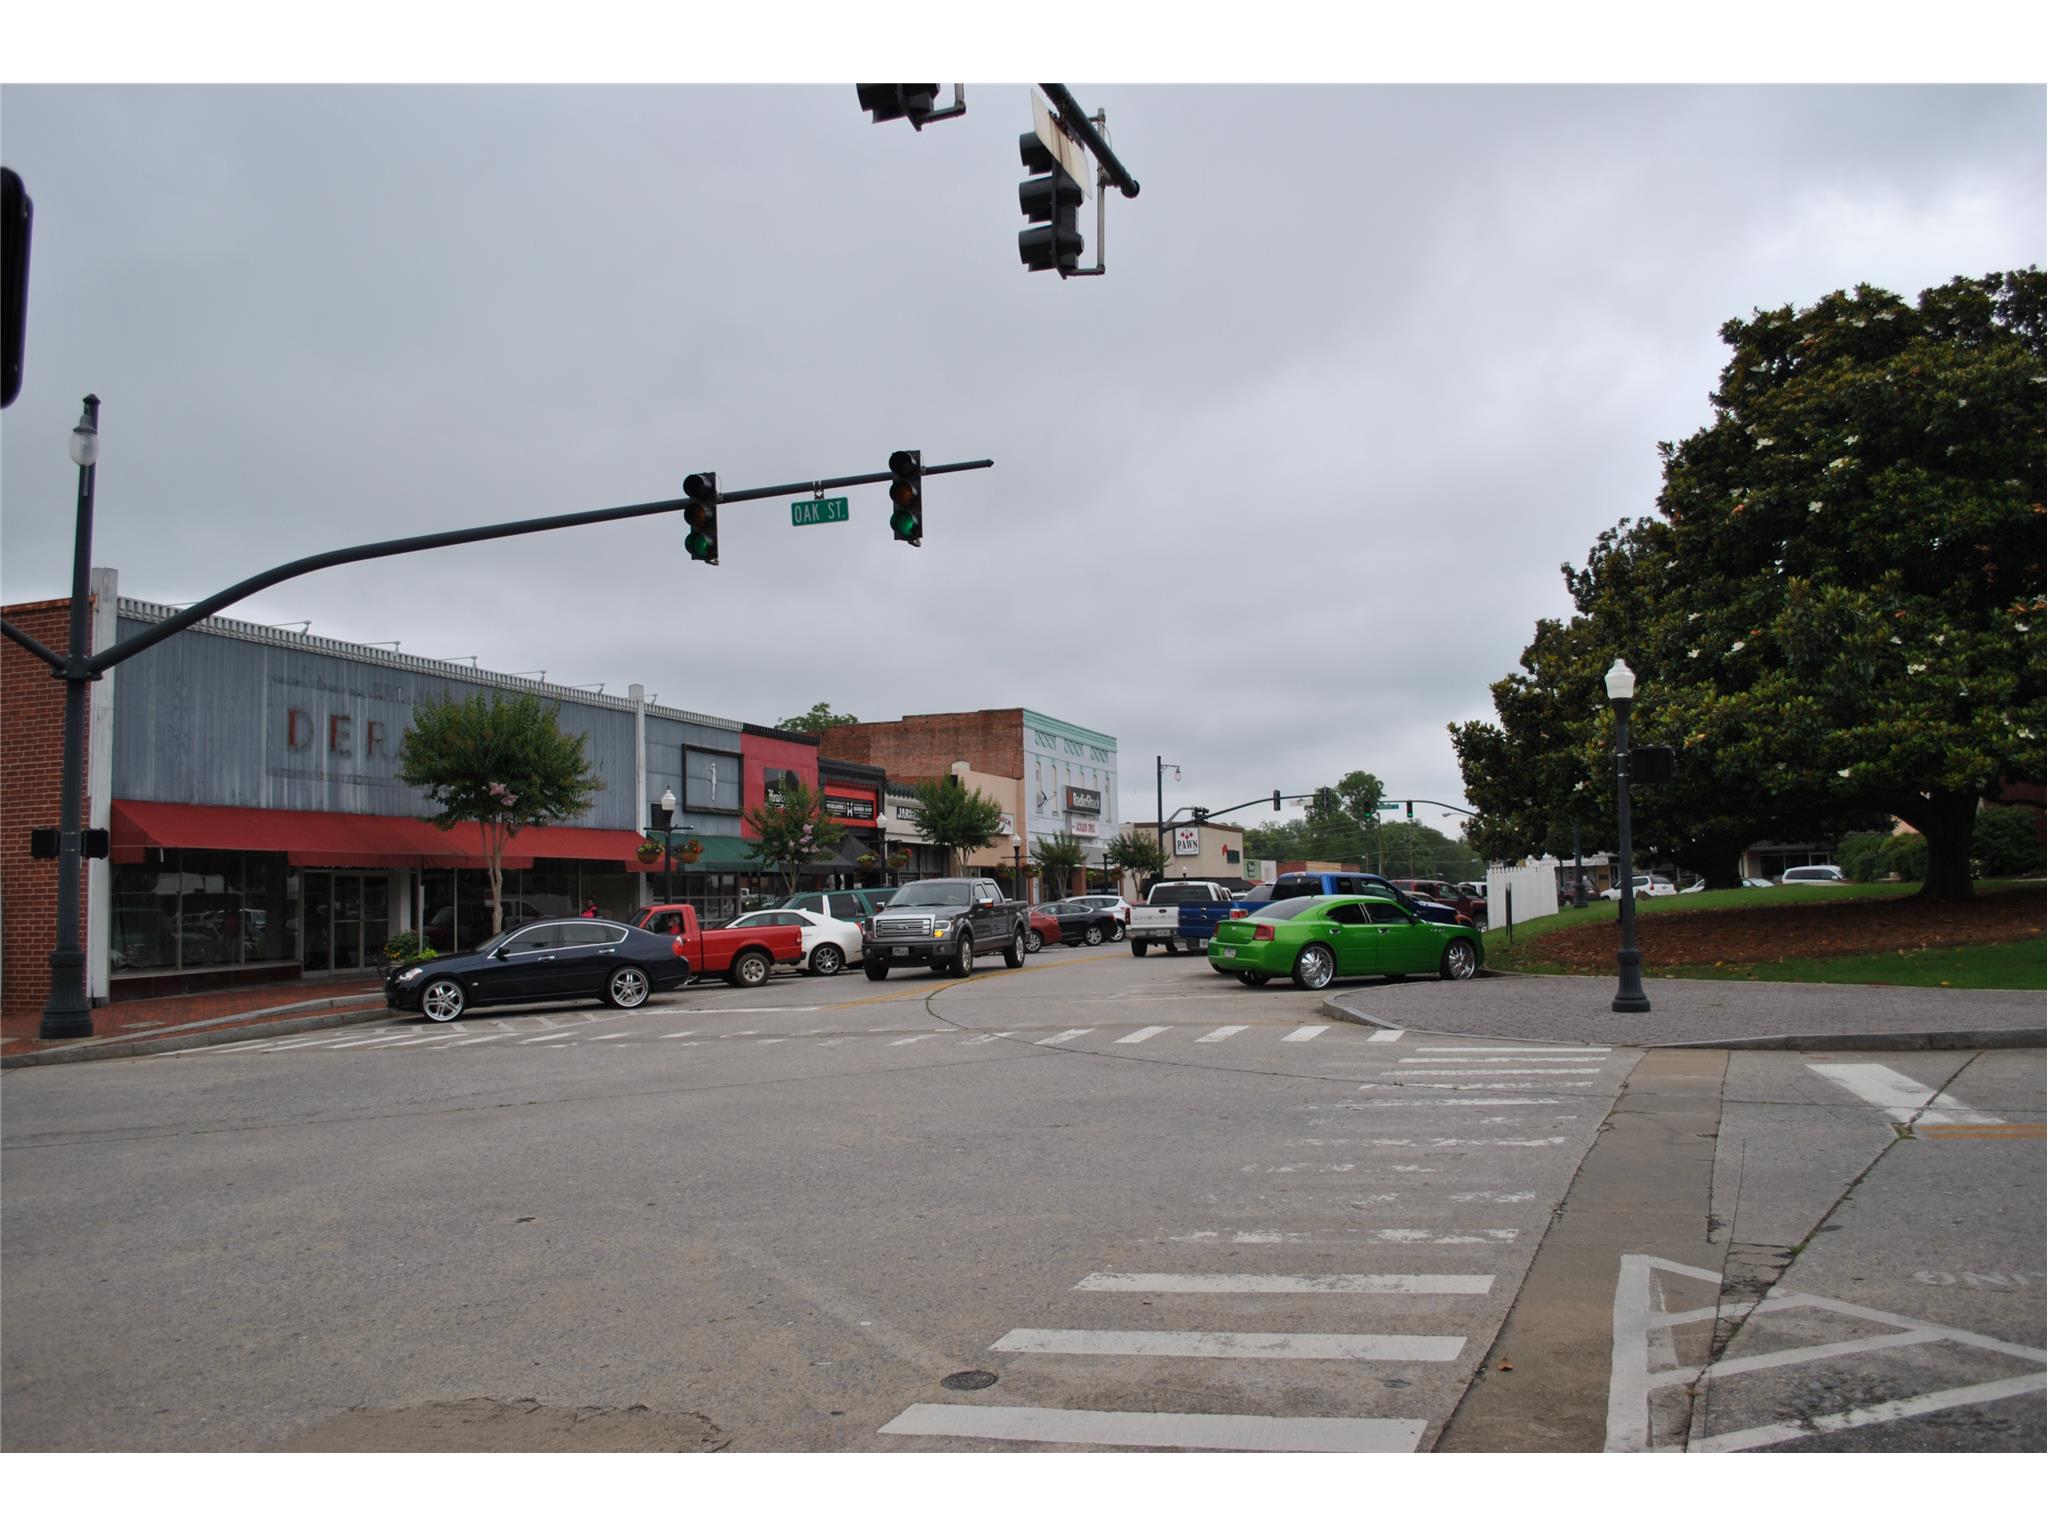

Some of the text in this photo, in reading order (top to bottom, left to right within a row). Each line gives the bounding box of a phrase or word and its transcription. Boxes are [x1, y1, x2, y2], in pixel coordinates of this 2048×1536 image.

[794, 501, 845, 523] OAK ST.
[1177, 840, 1198, 850] PAWN
